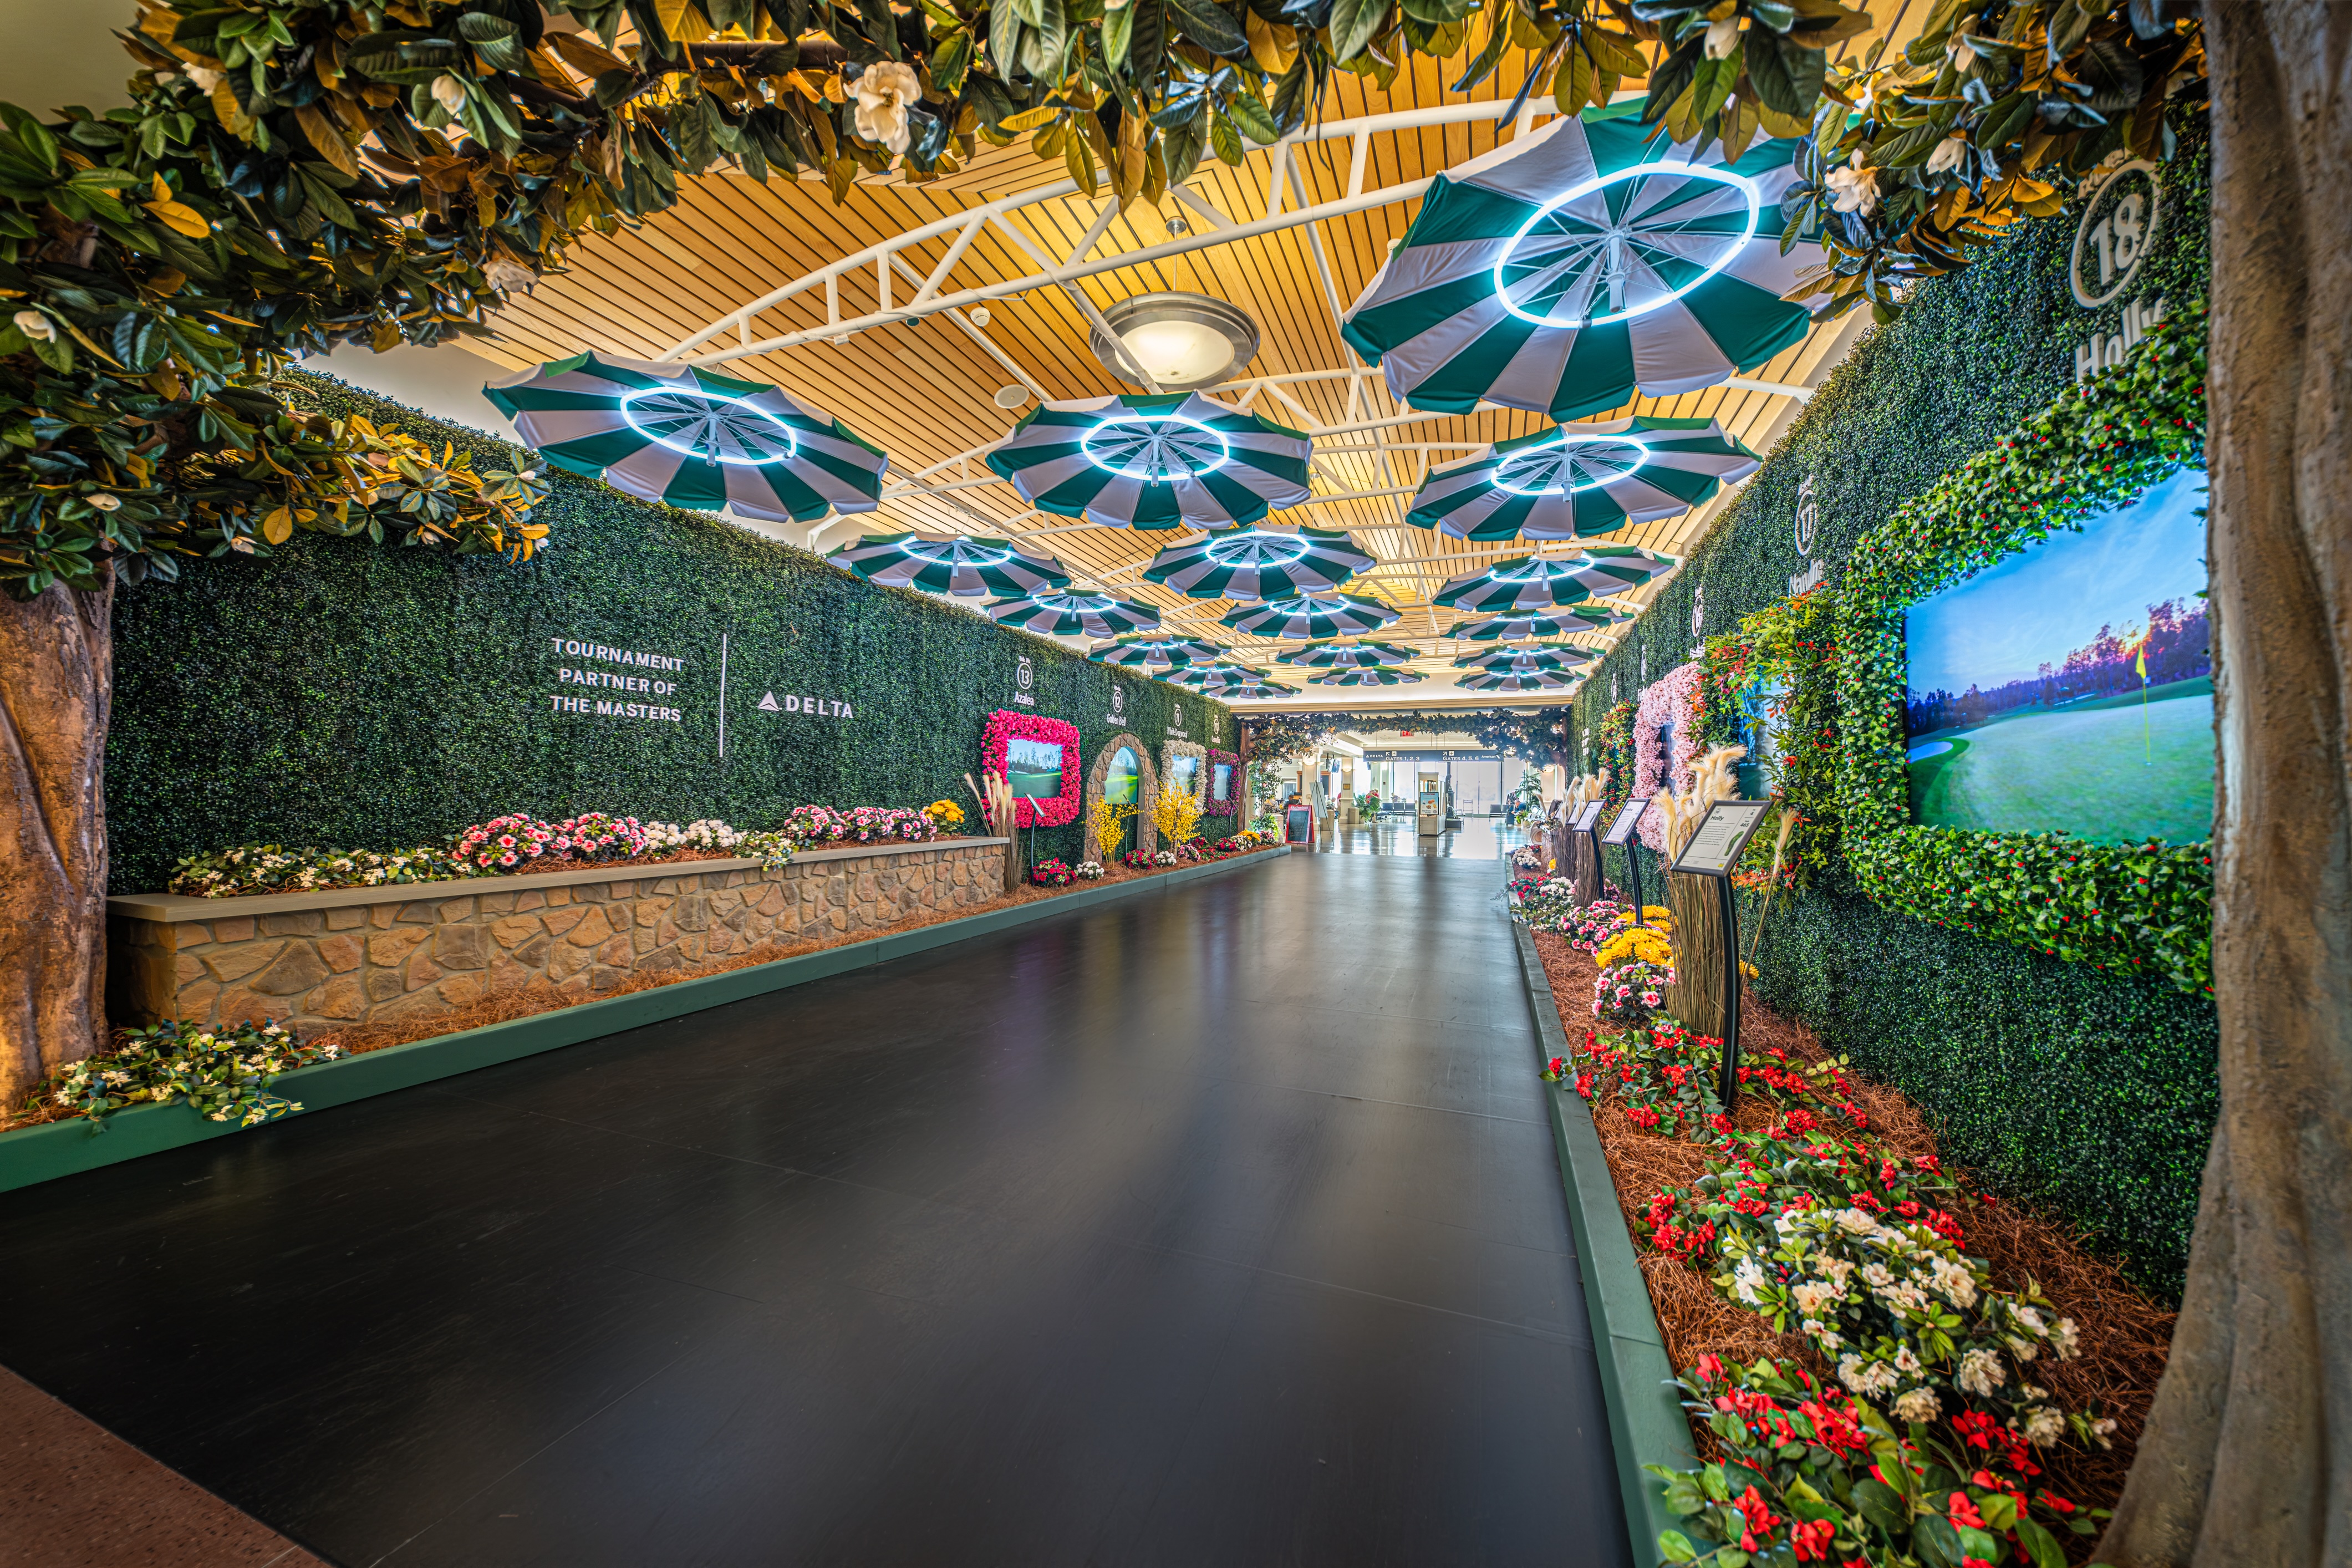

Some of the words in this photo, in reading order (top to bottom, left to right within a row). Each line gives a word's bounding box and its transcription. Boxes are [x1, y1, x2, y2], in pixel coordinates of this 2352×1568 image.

[2090, 194, 2142, 286] 18
[2075, 295, 2164, 383] Holly
[1800, 502, 1815, 542] 17
[551, 638, 684, 671] TOURNAMENT
[559, 668, 650, 693] PARTNER
[653, 680, 677, 696] OF
[1020, 669, 1030, 685] 13
[549, 695, 590, 713] THE
[596, 700, 681, 722] MASTERS
[786, 695, 853, 719] DELTA
[1014, 691, 1034, 706] Azalea
[1115, 696, 1121, 708] 12
[1107, 714, 1119, 725] Golden
[1176, 713, 1179, 723] 11
[1175, 728, 1188, 739] Dogwood
